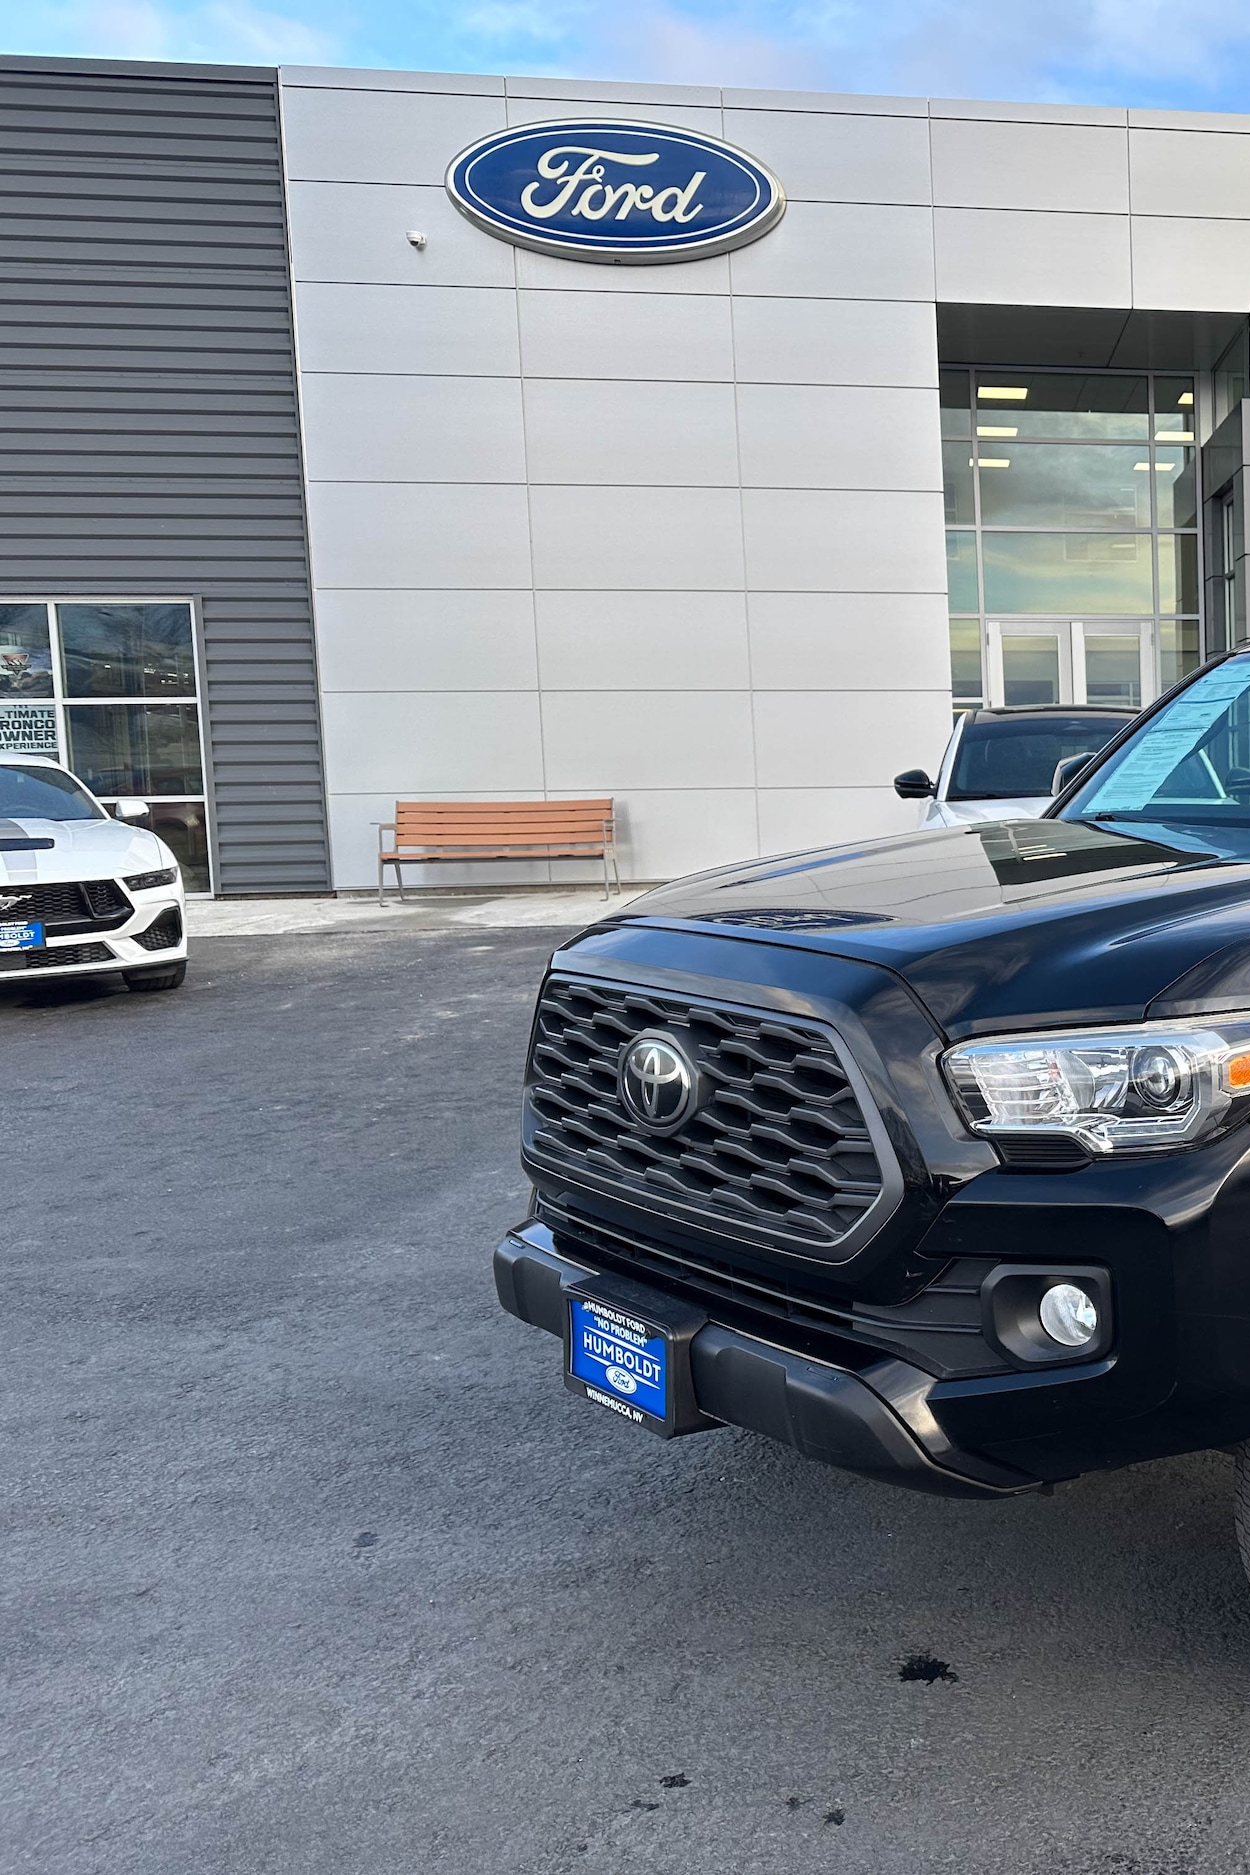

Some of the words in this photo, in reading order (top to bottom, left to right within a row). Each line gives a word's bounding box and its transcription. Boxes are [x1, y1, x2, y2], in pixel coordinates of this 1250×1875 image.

[521, 146, 708, 224] Ford
[0, 730, 57, 741] WNER
[587, 1301, 626, 1325] HUMBOLDT
[626, 1317, 646, 1334] FORD
[583, 1331, 662, 1383] HUMBOLDT
[632, 1407, 644, 1423] NV
